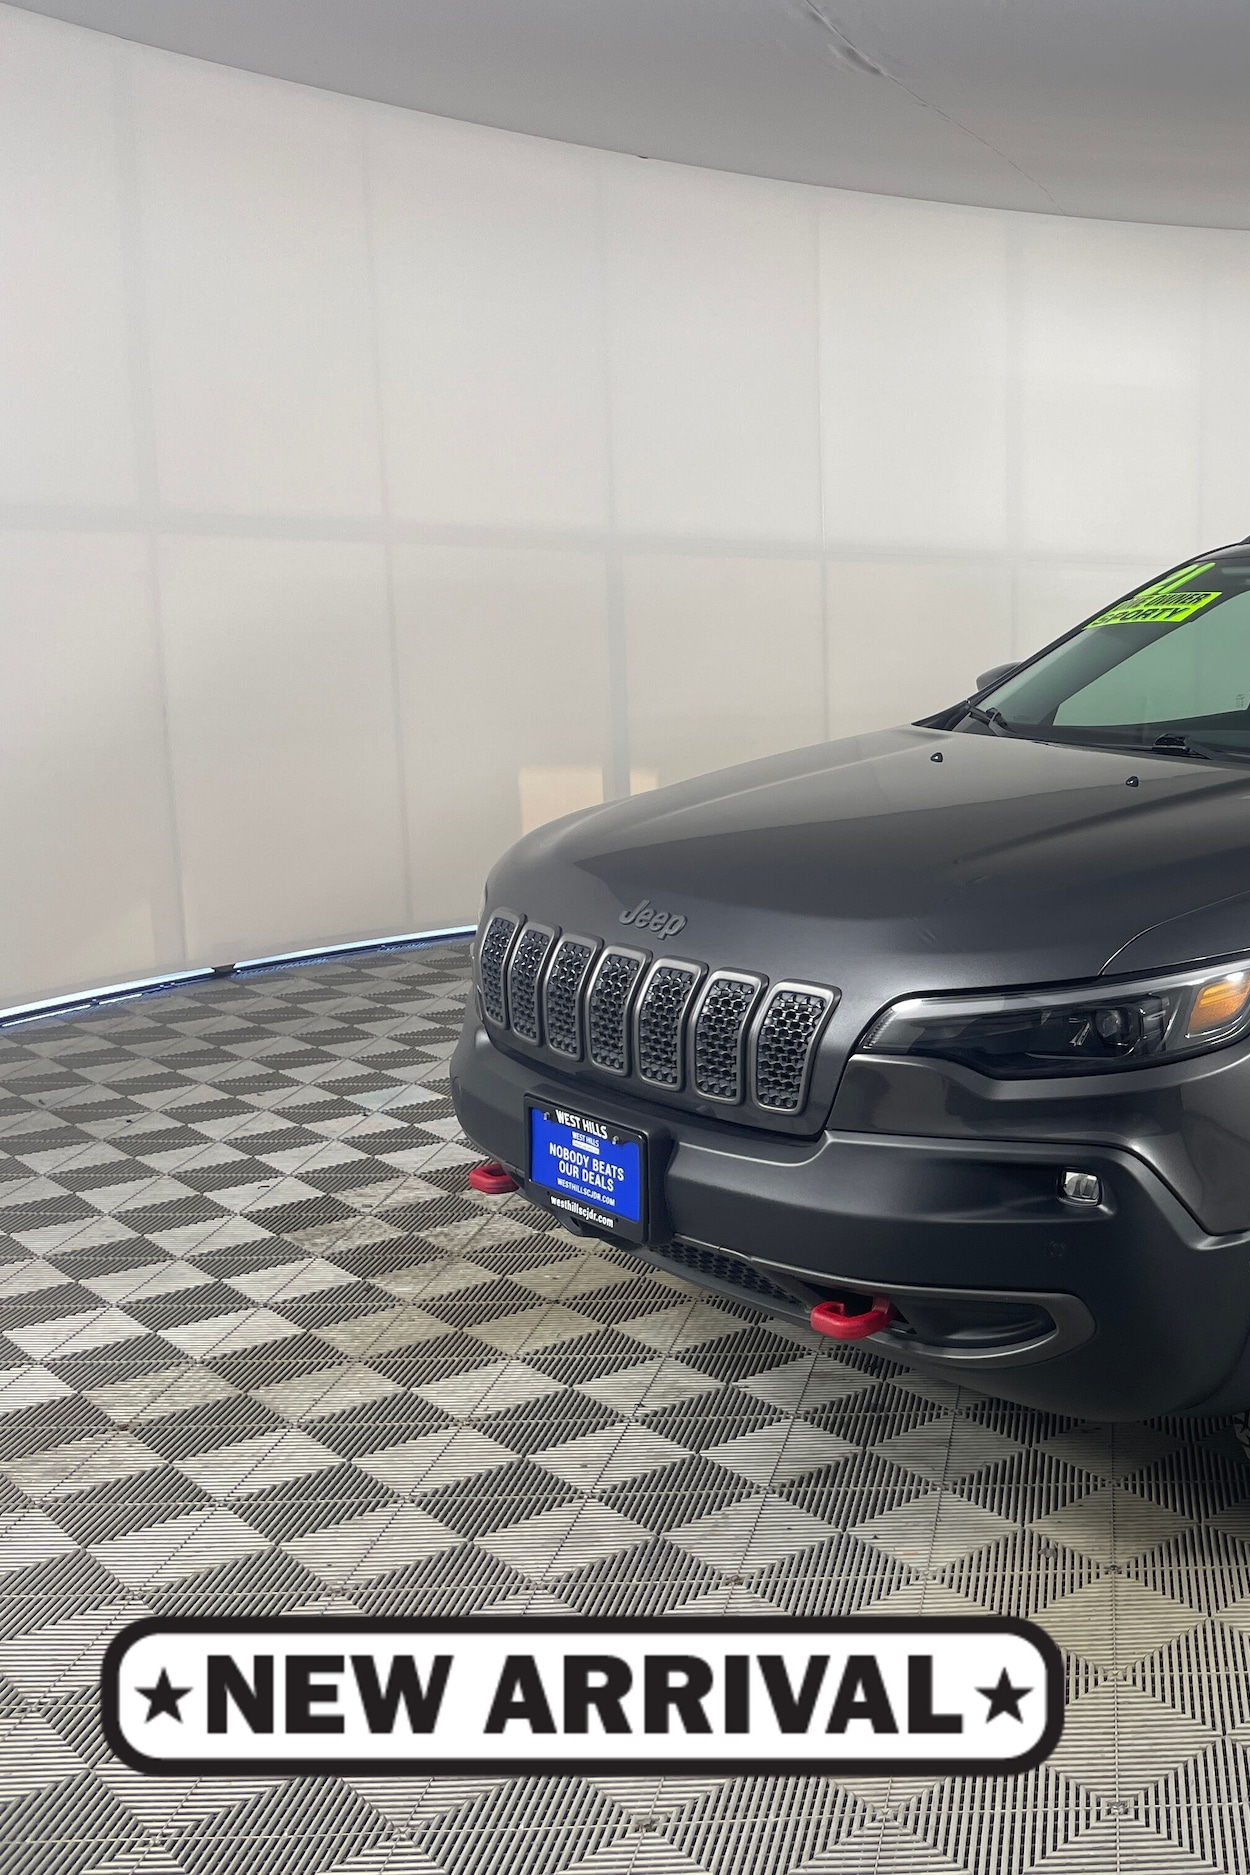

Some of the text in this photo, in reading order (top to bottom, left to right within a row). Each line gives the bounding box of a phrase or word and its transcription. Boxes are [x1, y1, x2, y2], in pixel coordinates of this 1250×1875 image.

[1144, 593, 1212, 607] OWNER
[1092, 608, 1190, 626] SPORTY
[619, 899, 688, 940] Jeep
[555, 1109, 608, 1140] WEST HILLS
[571, 1131, 586, 1142] WEST
[549, 1142, 624, 1182] NOBODY BEATS
[559, 1160, 614, 1192] OUR DEALS
[557, 1178, 616, 1206] WESTHILLSCJDR.COM
[551, 1196, 614, 1228] westhillscjdr.com
